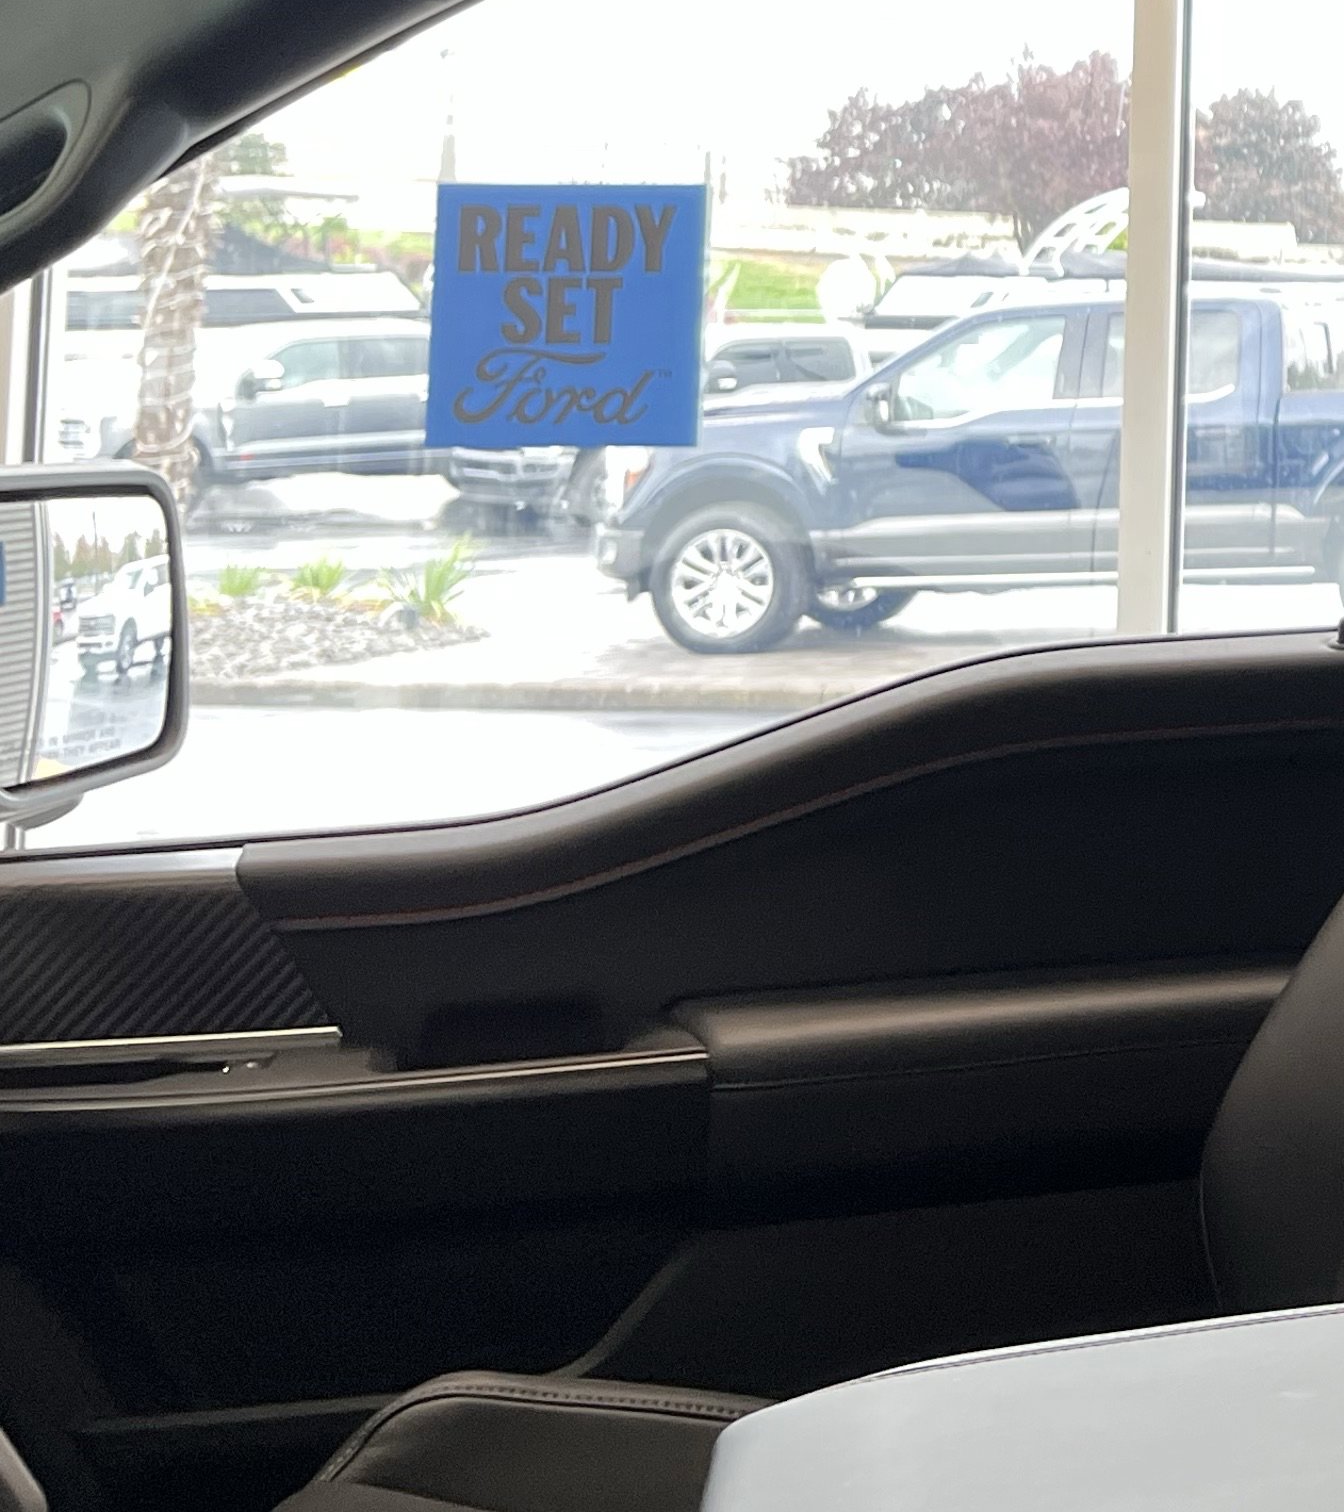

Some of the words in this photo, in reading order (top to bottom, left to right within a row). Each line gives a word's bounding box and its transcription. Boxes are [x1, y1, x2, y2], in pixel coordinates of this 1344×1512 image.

[457, 203, 677, 273] READY
[502, 276, 624, 346] SET
[453, 346, 656, 426] Ford
